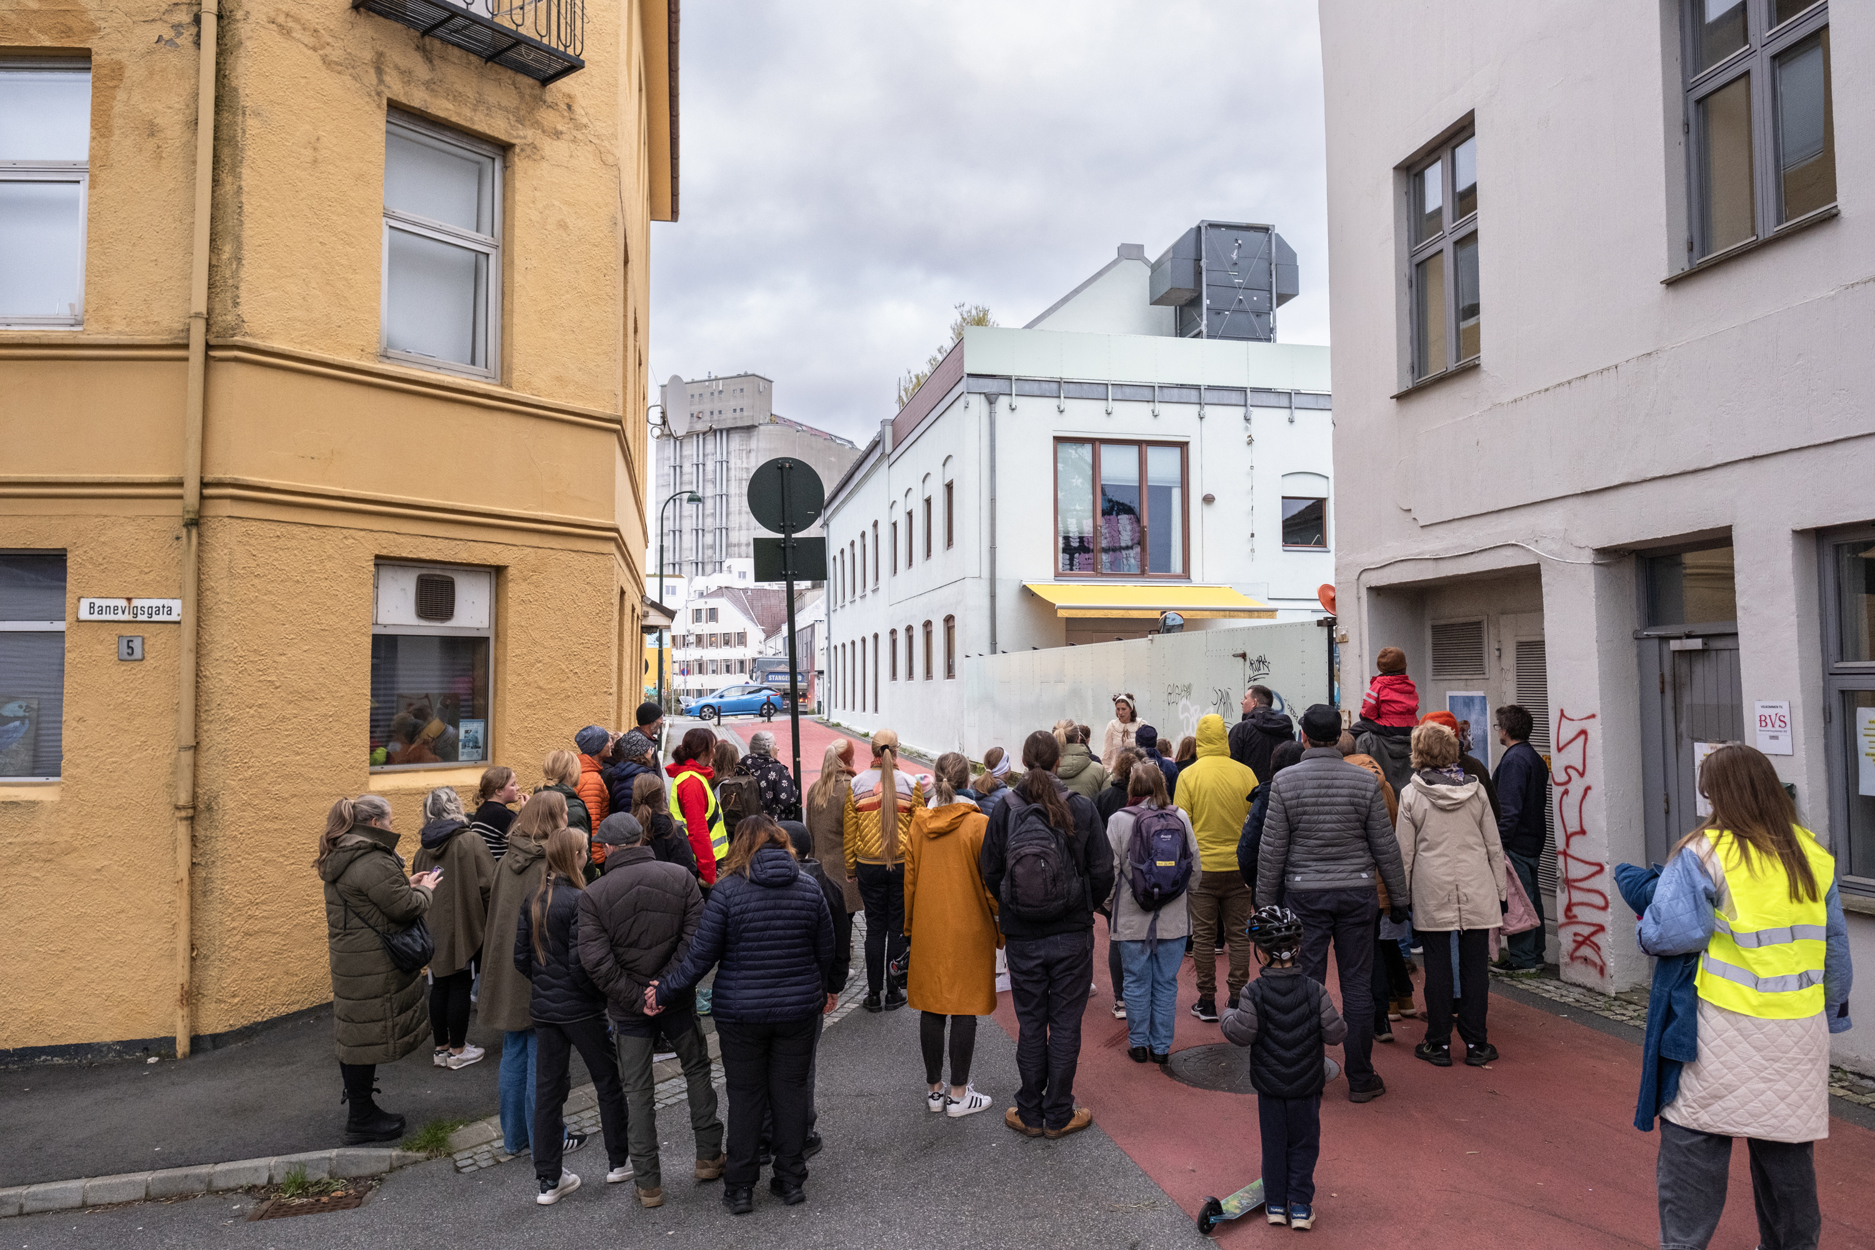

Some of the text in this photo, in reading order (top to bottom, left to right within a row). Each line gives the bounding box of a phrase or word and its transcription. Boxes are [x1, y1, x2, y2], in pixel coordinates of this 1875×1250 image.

[88, 601, 173, 619] Banevigsgata
[126, 639, 135, 657] 5
[1758, 712, 1787, 729] BVS
